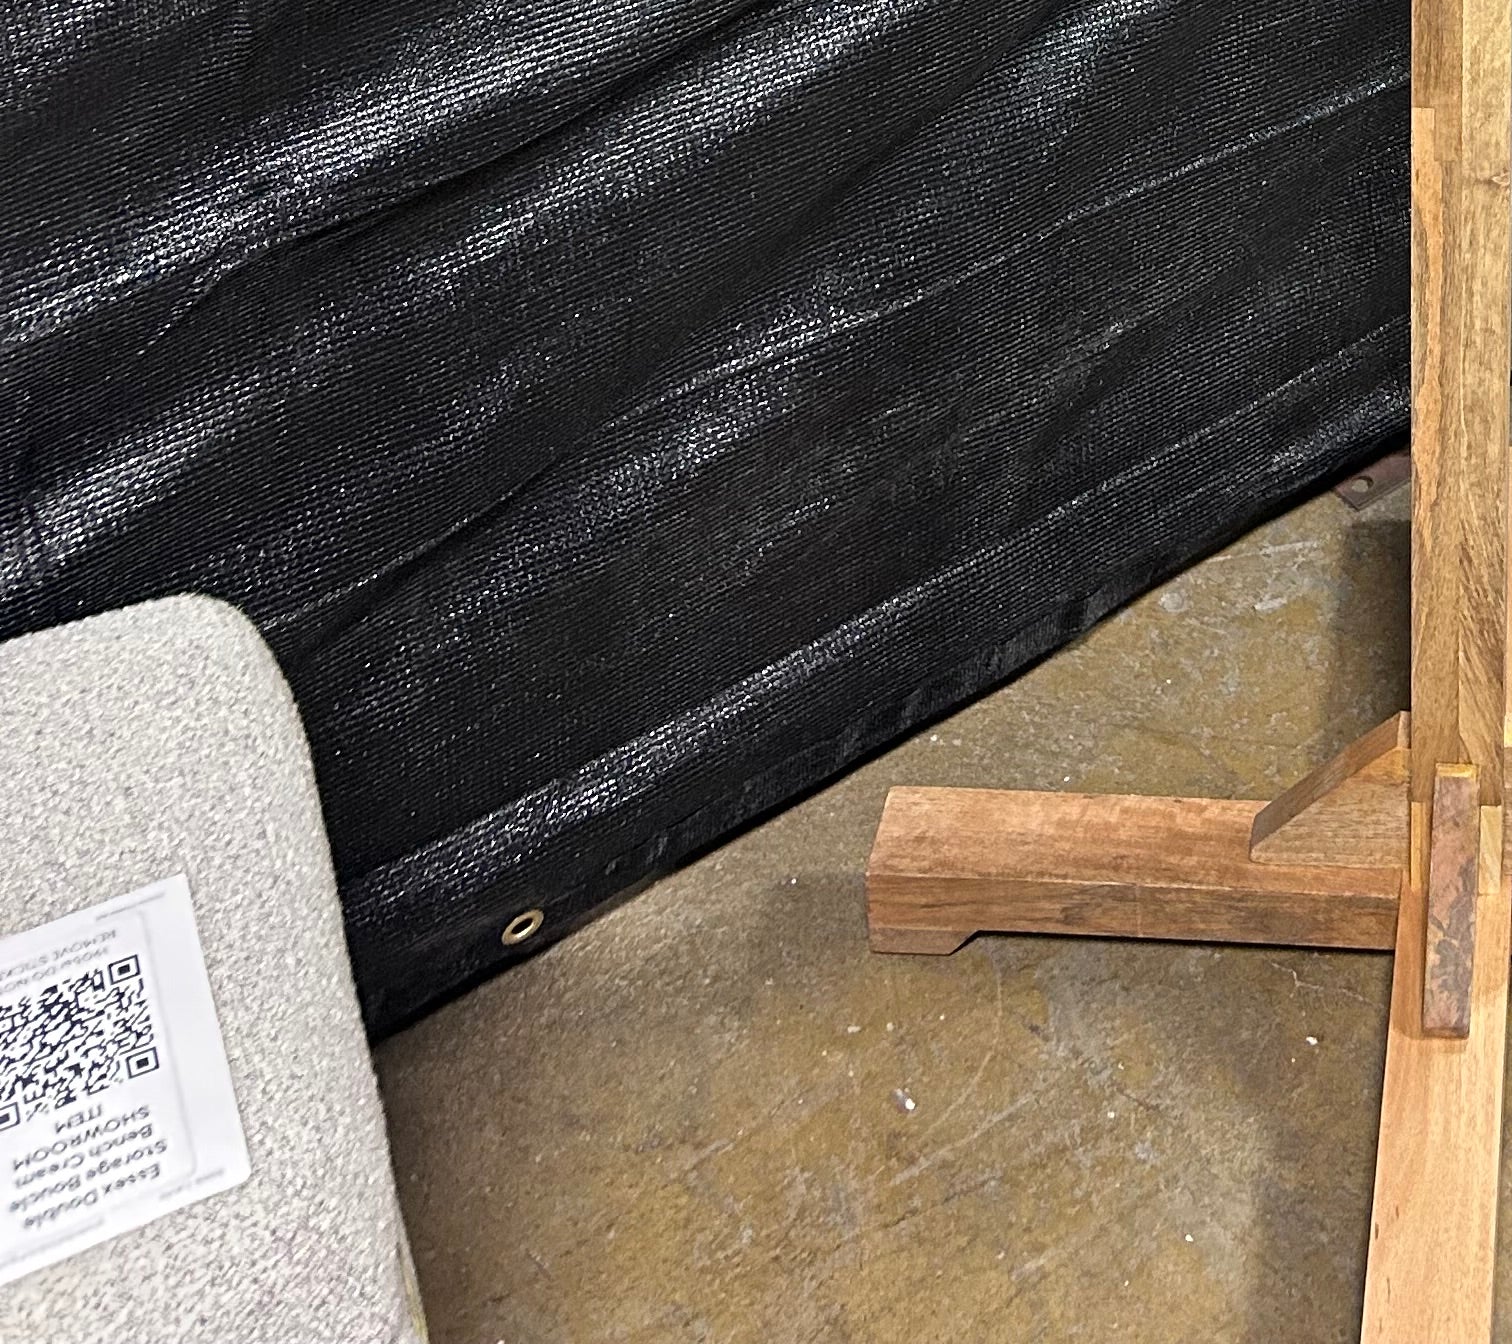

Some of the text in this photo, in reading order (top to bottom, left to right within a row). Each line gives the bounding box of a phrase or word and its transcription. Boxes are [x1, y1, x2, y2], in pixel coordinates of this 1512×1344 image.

[13, 1104, 151, 1171] SHOWROOM
[54, 1104, 103, 1134] ITEM
[9, 1138, 168, 1212] Storage Boucle
[15, 1123, 153, 1189] Bench Cream
[102, 1162, 161, 1195] Essex
[23, 1188, 99, 1229] Double
